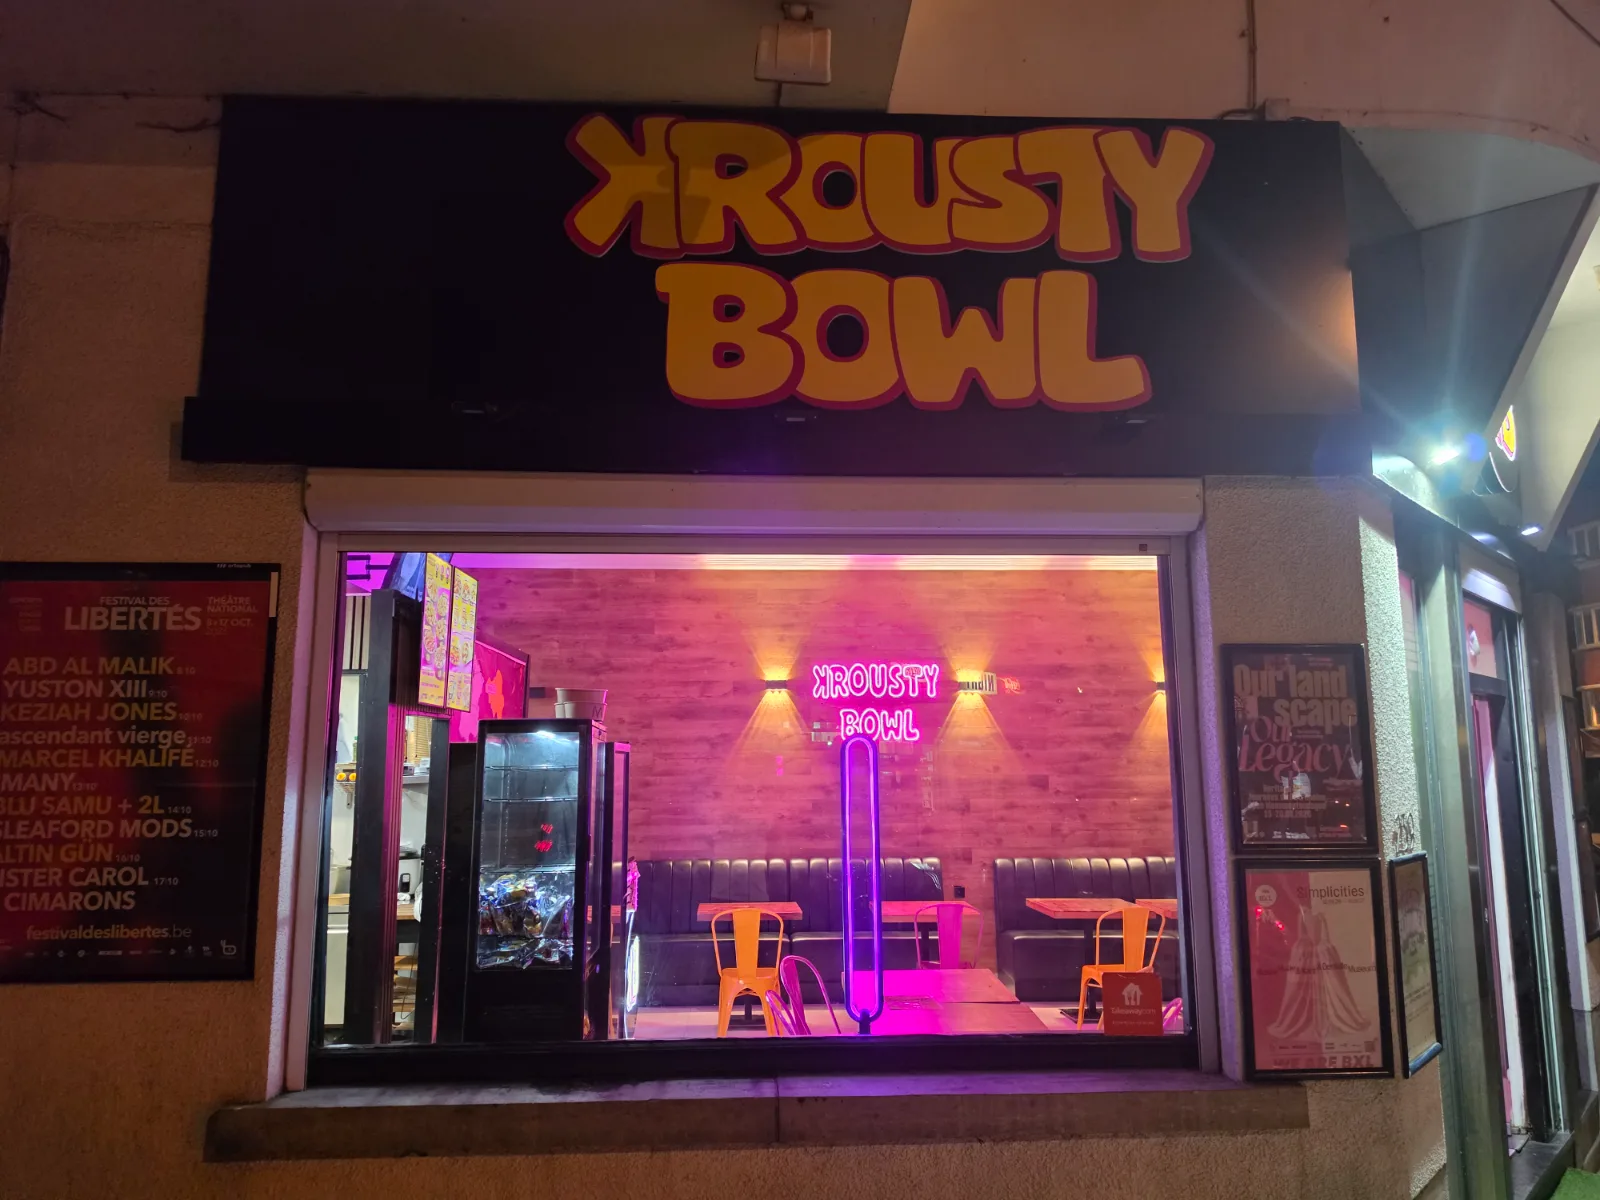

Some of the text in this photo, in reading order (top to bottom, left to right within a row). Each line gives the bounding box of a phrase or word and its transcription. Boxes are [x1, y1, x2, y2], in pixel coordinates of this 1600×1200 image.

[564, 113, 1215, 262] KROUSTY
[655, 262, 1152, 412] BOWL
[99, 596, 171, 606] FESTIVAL DES
[206, 605, 259, 614] NATIONAL
[64, 603, 203, 631] LIBERTÉS
[3, 657, 57, 676] ABD
[62, 657, 93, 676] AL
[98, 656, 175, 675] MALIK
[2, 679, 104, 698] YUSTON
[109, 679, 148, 698] XIII
[812, 663, 939, 699] KROUSTY
[1289, 664, 1347, 698] land
[0, 702, 91, 721] KEZIAH
[96, 702, 178, 721] JONES
[1273, 698, 1358, 735] scape
[839, 708, 920, 742] BOWL
[0, 725, 113, 745] ascendant
[117, 725, 187, 749] vierge
[0, 748, 94, 768] MARCEL
[1238, 733, 1352, 784] Legacy
[41, 795, 112, 815] SAMU
[137, 795, 165, 815] 2L
[119, 818, 193, 838] MODS
[60, 838, 114, 863] GÜN
[69, 867, 149, 887] CAROL
[4, 890, 136, 911] CIMARONS
[1296, 885, 1365, 900] Simplicities
[26, 924, 193, 941] festivaldeslibertes.be
[1342, 1055, 1374, 1069] BXL
